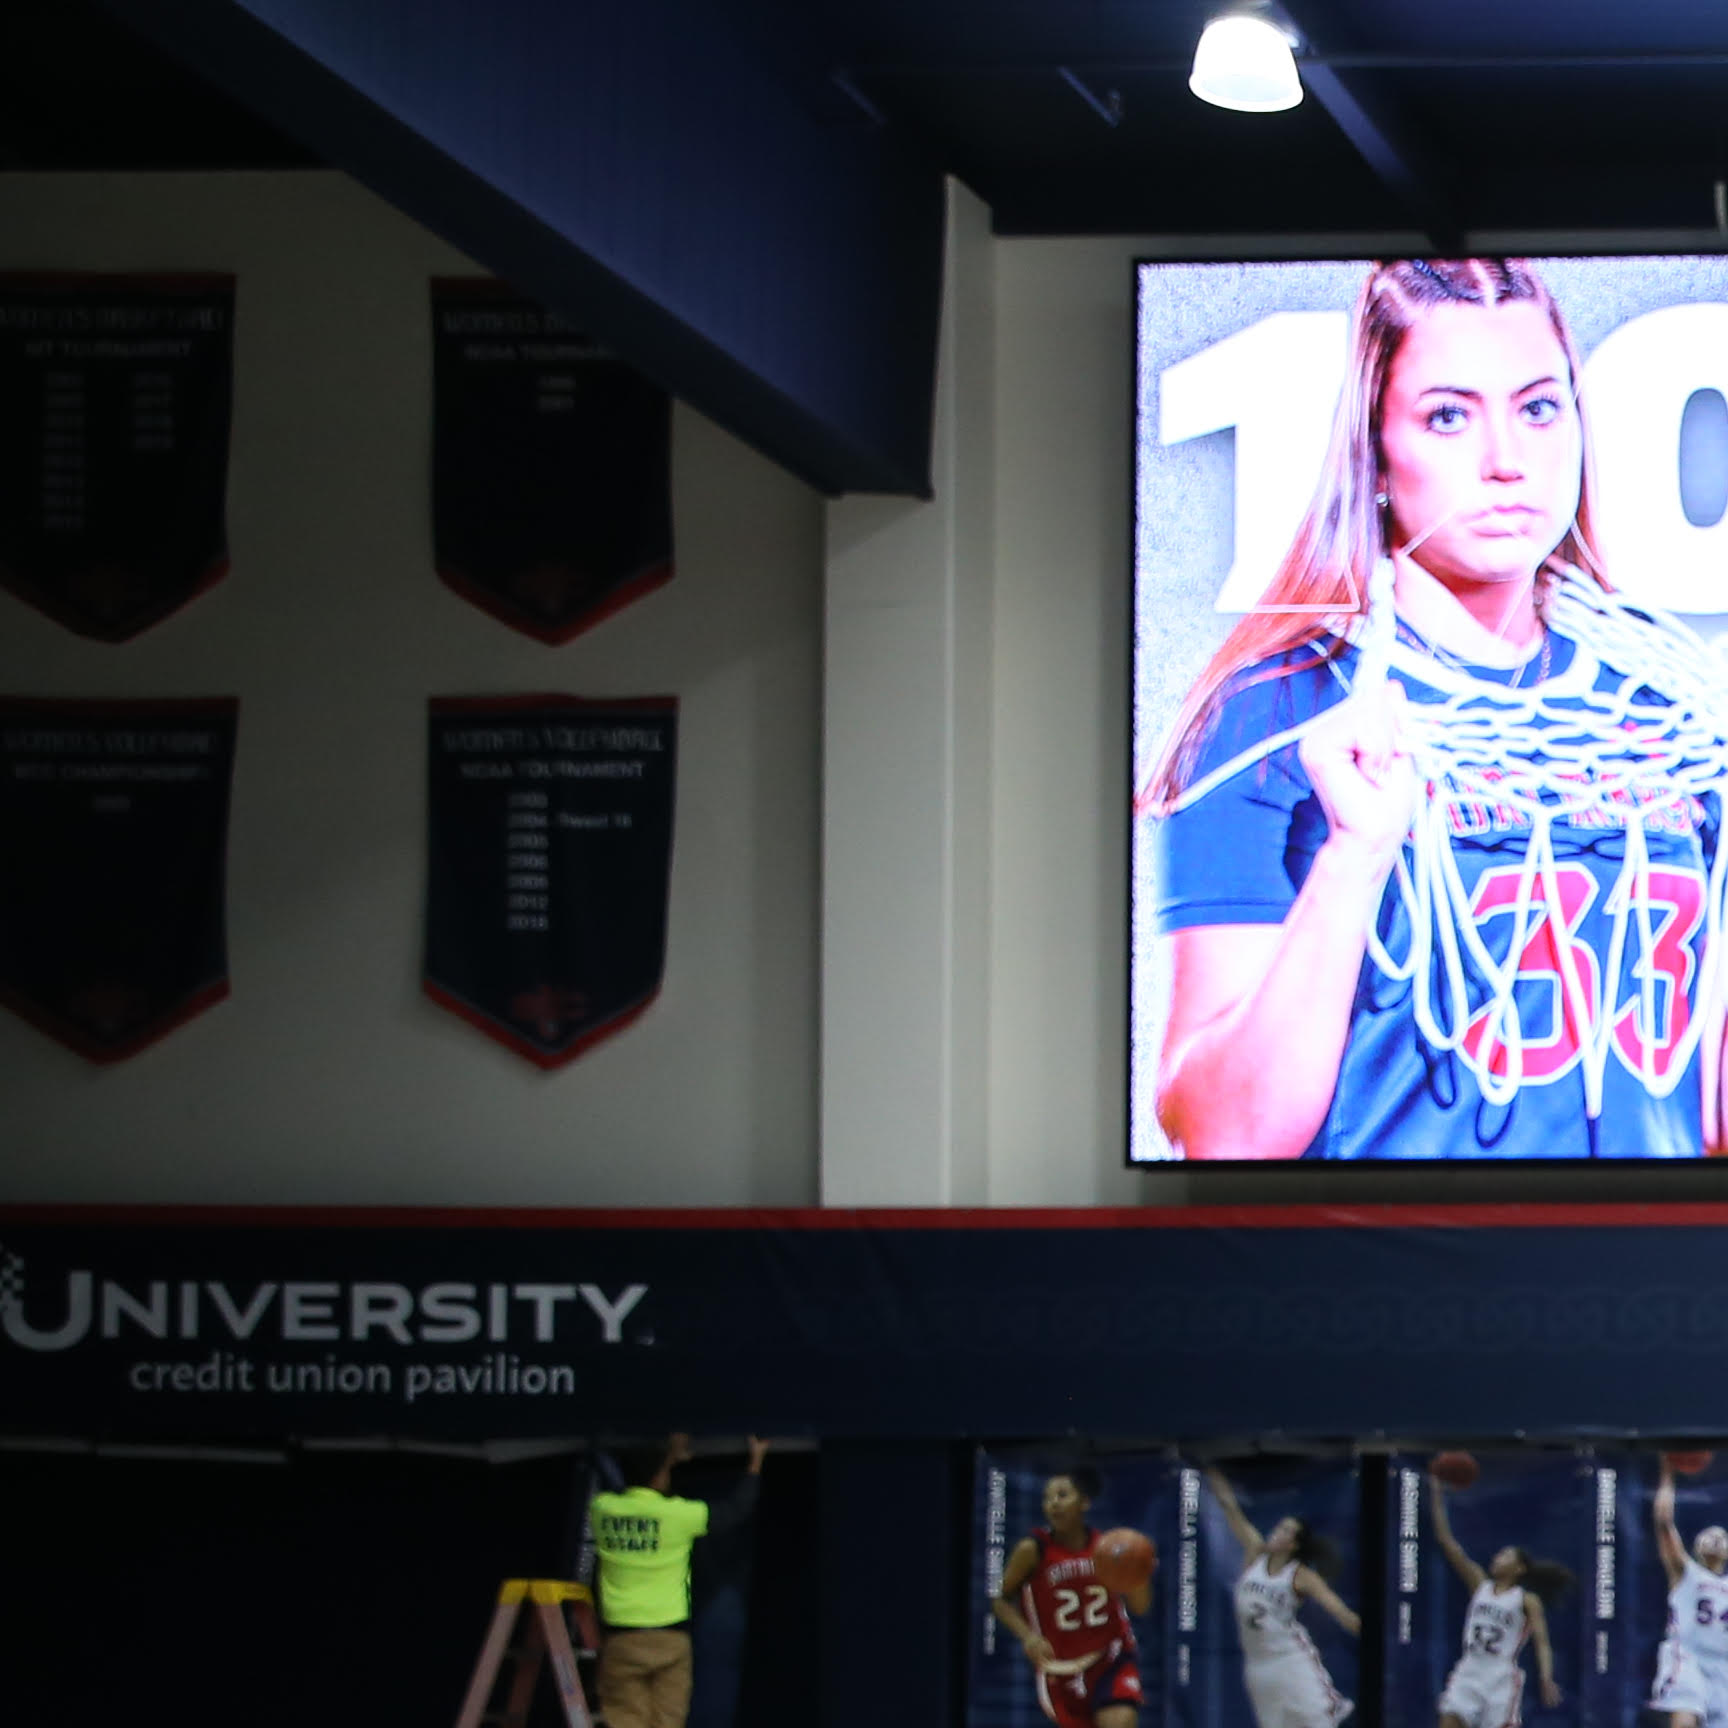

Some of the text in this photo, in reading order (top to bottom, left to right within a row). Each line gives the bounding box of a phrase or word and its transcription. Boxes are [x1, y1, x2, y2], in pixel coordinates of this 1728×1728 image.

[1, 1262, 648, 1352] UNIVERSITY
[129, 1356, 575, 1403] credit union pavilion
[1055, 1585, 1109, 1632] 22
